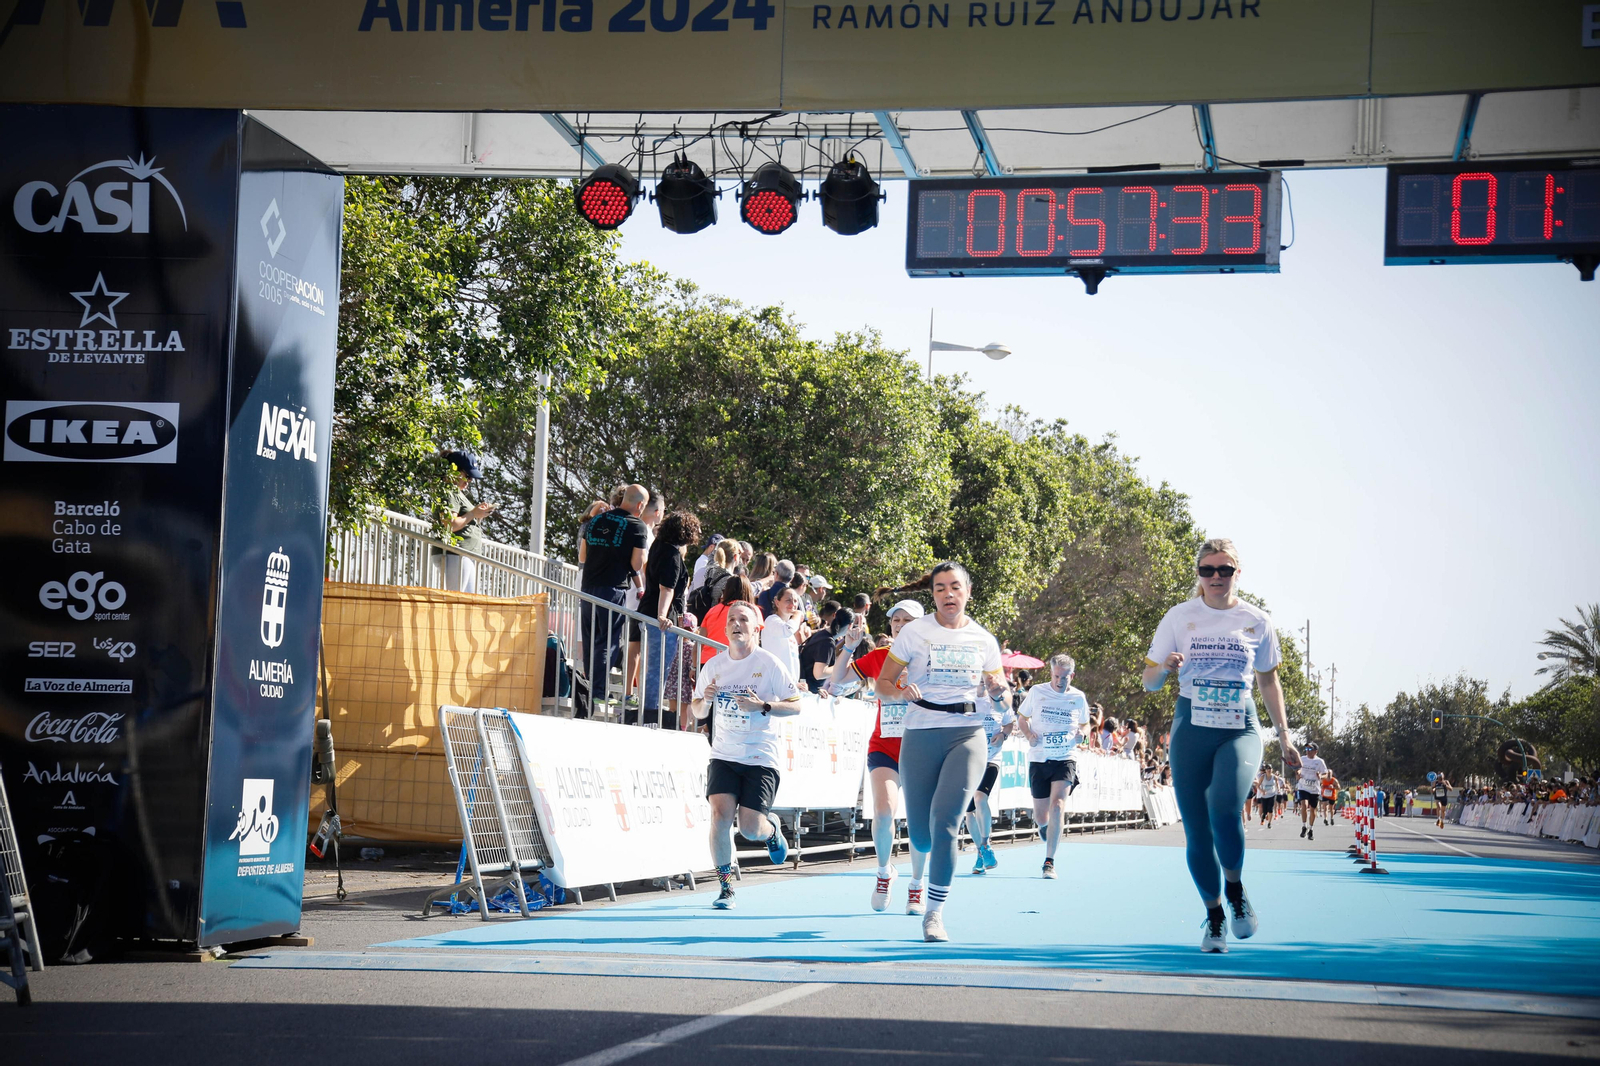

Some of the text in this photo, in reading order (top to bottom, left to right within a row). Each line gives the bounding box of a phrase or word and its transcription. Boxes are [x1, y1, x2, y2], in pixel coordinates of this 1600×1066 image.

[607, 0, 775, 33] 2024
[812, 1, 949, 29] RAMÓN
[968, 0, 1057, 28] RUIZ
[13, 180, 150, 233] CASI
[259, 260, 324, 307] COOPERACIÓN
[259, 280, 283, 305] 2005
[7, 328, 186, 352] ESTRELLA
[48, 353, 145, 364] DE LEVANTE
[29, 419, 158, 445] IKEA
[54, 501, 120, 516] Barceló
[52, 519, 121, 536] Cabo de
[52, 538, 92, 554] Gata
[39, 571, 127, 620] ego
[94, 613, 110, 621] sport
[28, 641, 76, 658] SER
[1190, 642, 1250, 654] Almería 2024
[249, 658, 294, 685] ALMERÍA
[27, 681, 130, 692] La Voz de Almería
[260, 683, 284, 699] CIUDAD
[1198, 687, 1241, 704] 5454
[717, 697, 739, 711] 573
[884, 705, 907, 718] 503
[25, 711, 126, 743] Coca-Cola
[22, 761, 119, 785] Andalucía
[562, 806, 592, 828] CIUDAD
